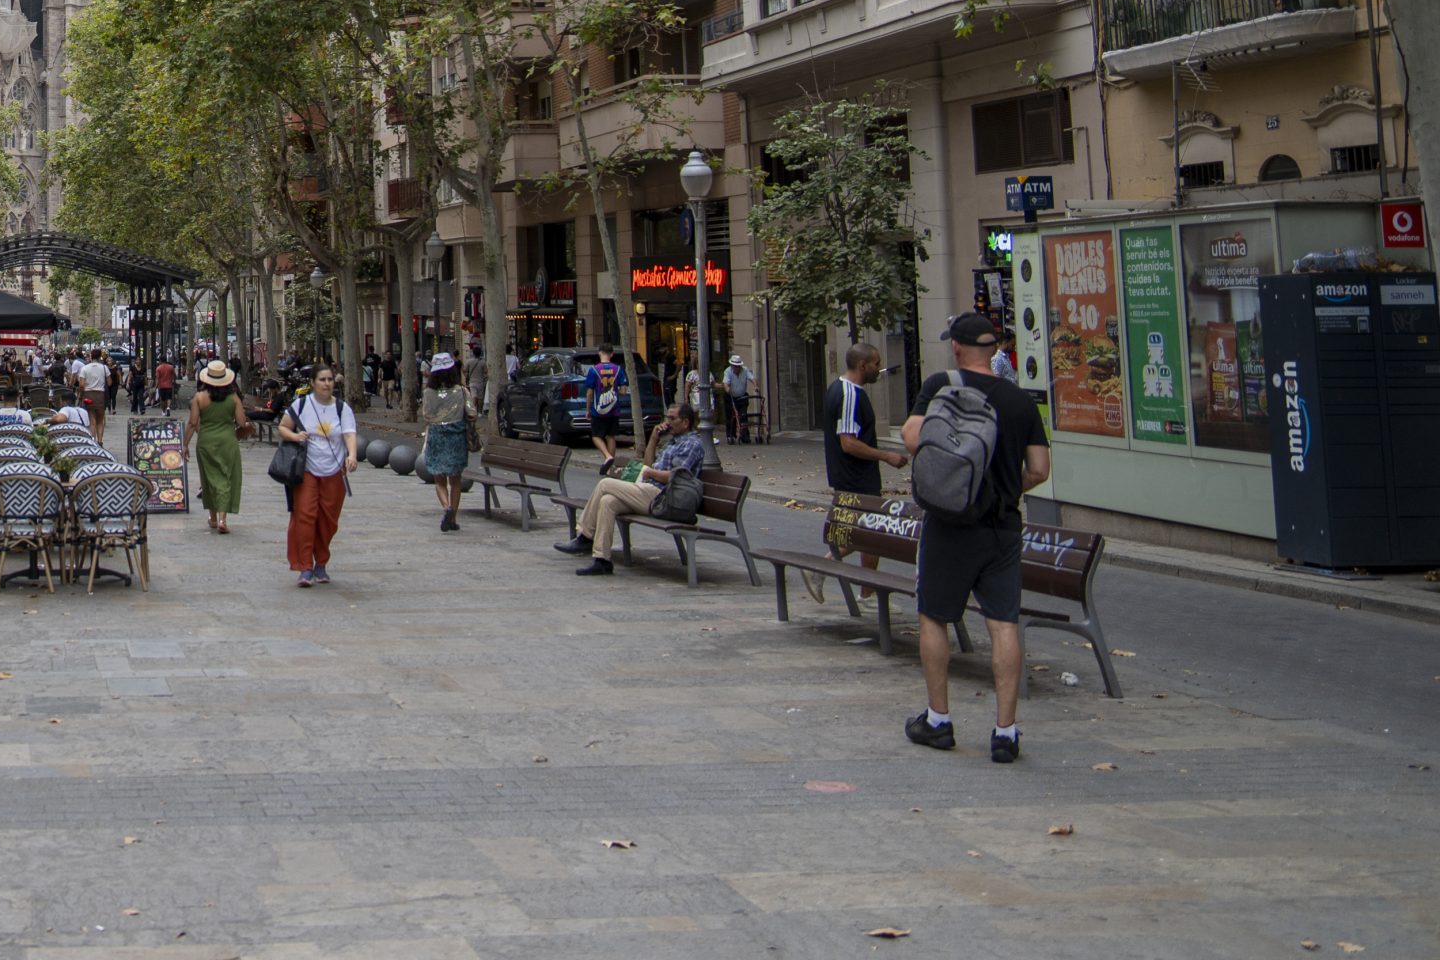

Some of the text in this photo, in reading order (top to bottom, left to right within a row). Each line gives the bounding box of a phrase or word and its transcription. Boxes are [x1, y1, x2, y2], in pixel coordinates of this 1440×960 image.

[1006, 183, 1021, 194] ATM
[1024, 182, 1052, 193] ATM
[1125, 236, 1158, 249] Quan fas
[1387, 234, 1420, 242] vodafone
[1126, 247, 1170, 260] servir bé els
[1211, 240, 1247, 257] ultima
[1126, 261, 1174, 272] contenidors,
[1127, 273, 1160, 284] cuides la
[1235, 276, 1259, 286] benefic
[1128, 286, 1171, 296] teva ciutat.
[1315, 284, 1368, 296] amazon
[1390, 290, 1425, 299] sanneh
[1105, 411, 1121, 421] KING
[1283, 361, 1305, 472] amazon
[141, 429, 173, 439] TAPAS
